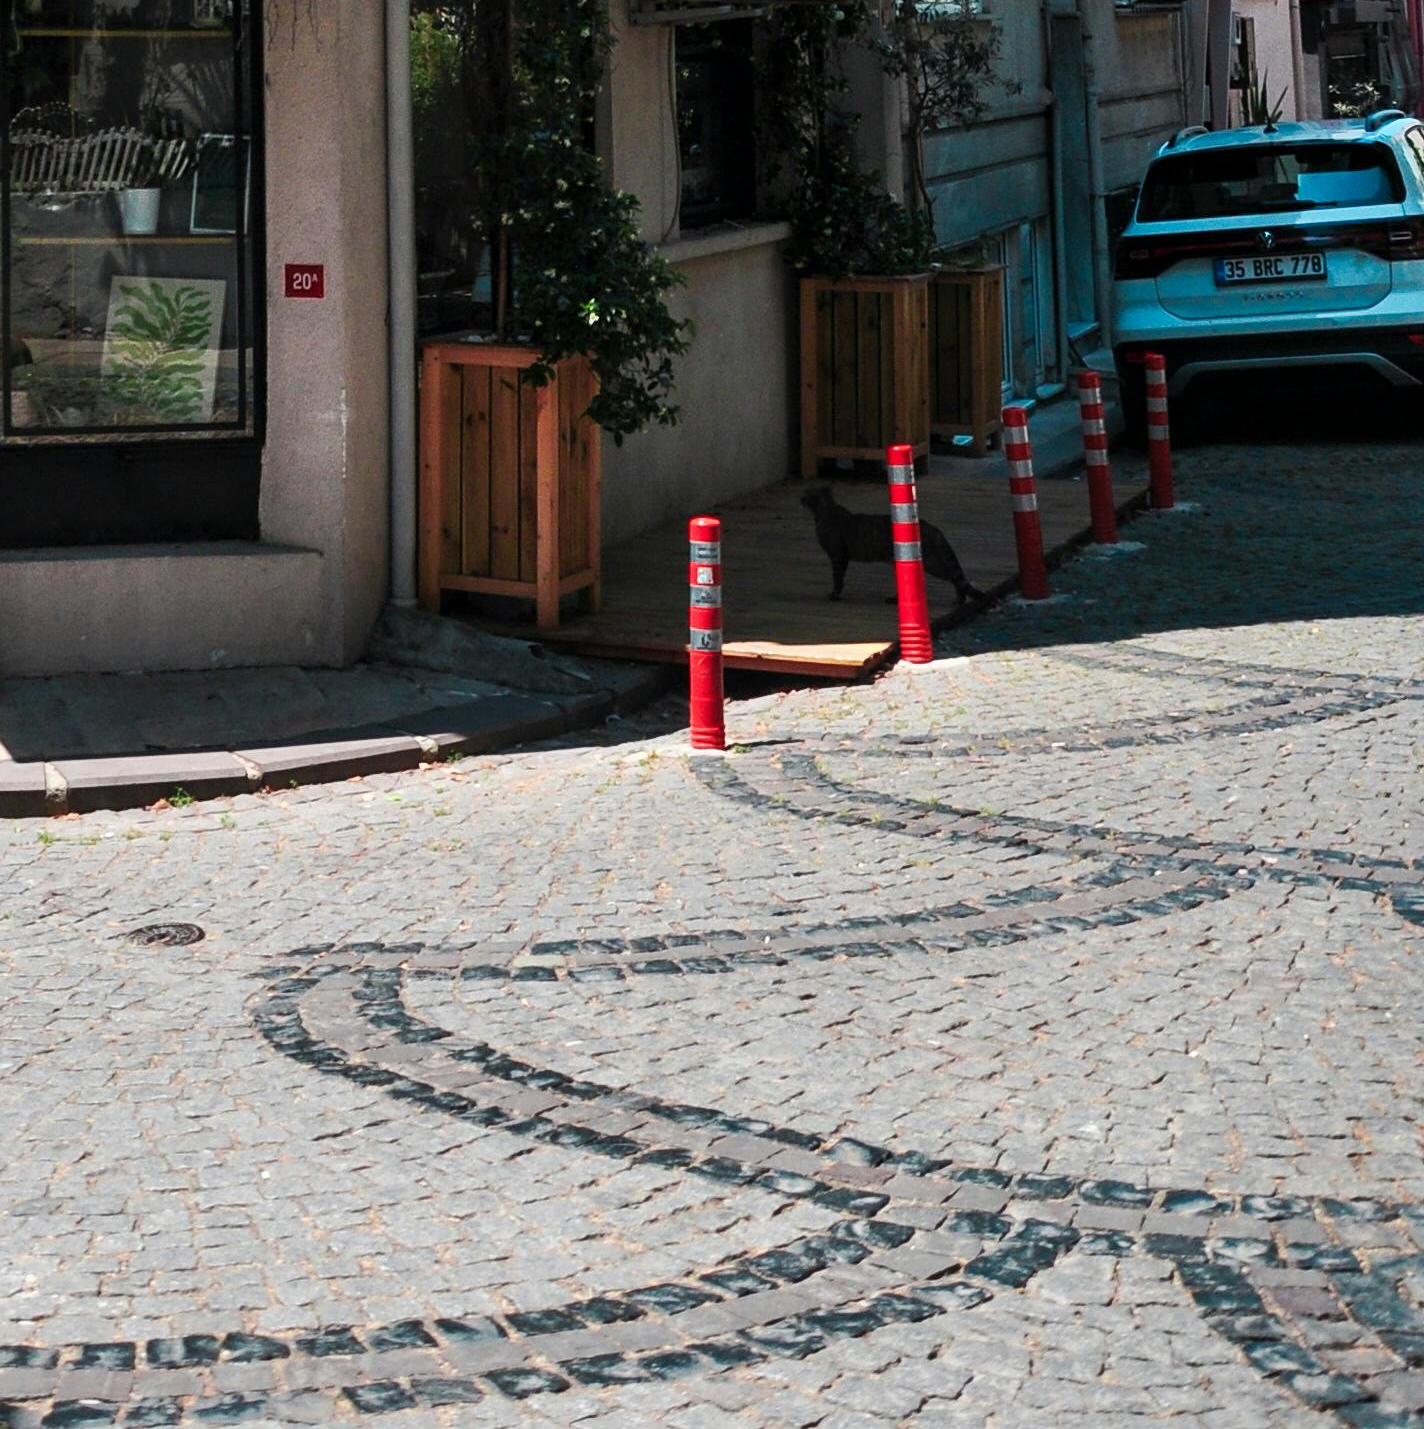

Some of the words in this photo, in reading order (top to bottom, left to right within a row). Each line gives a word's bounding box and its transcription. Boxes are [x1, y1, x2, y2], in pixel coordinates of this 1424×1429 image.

[1226, 261, 1245, 278] 35
[1253, 259, 1284, 276] BRC
[1291, 256, 1321, 274] 778
